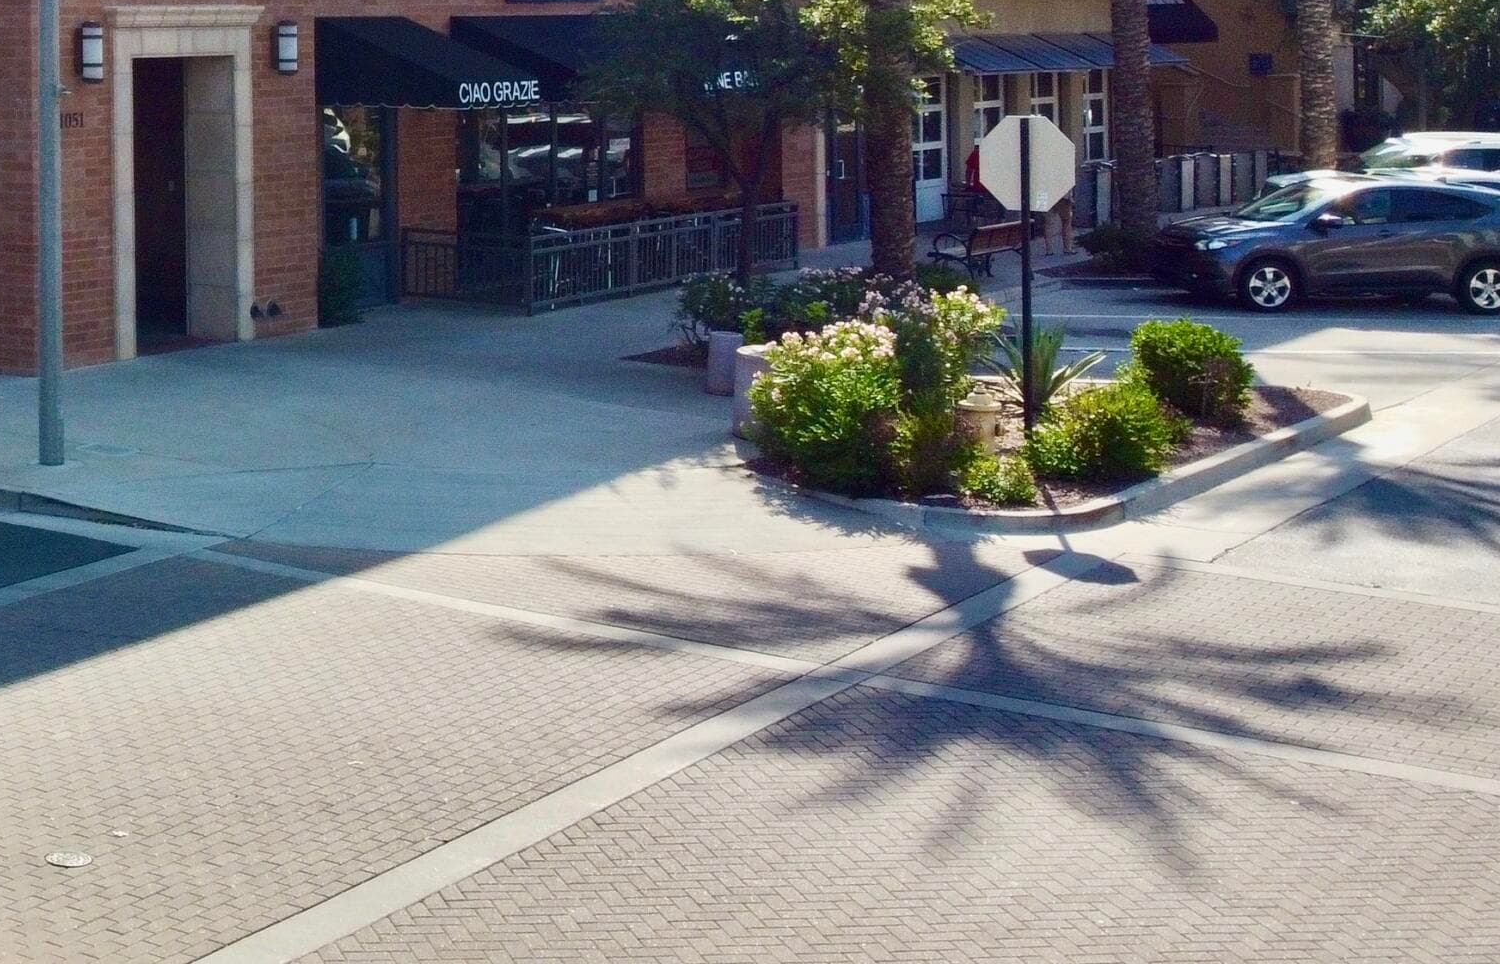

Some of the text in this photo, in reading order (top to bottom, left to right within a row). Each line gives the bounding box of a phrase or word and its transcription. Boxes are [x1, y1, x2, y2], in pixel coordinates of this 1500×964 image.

[459, 80, 540, 103] CIAO GRAZIE
[60, 112, 84, 128] 1051
